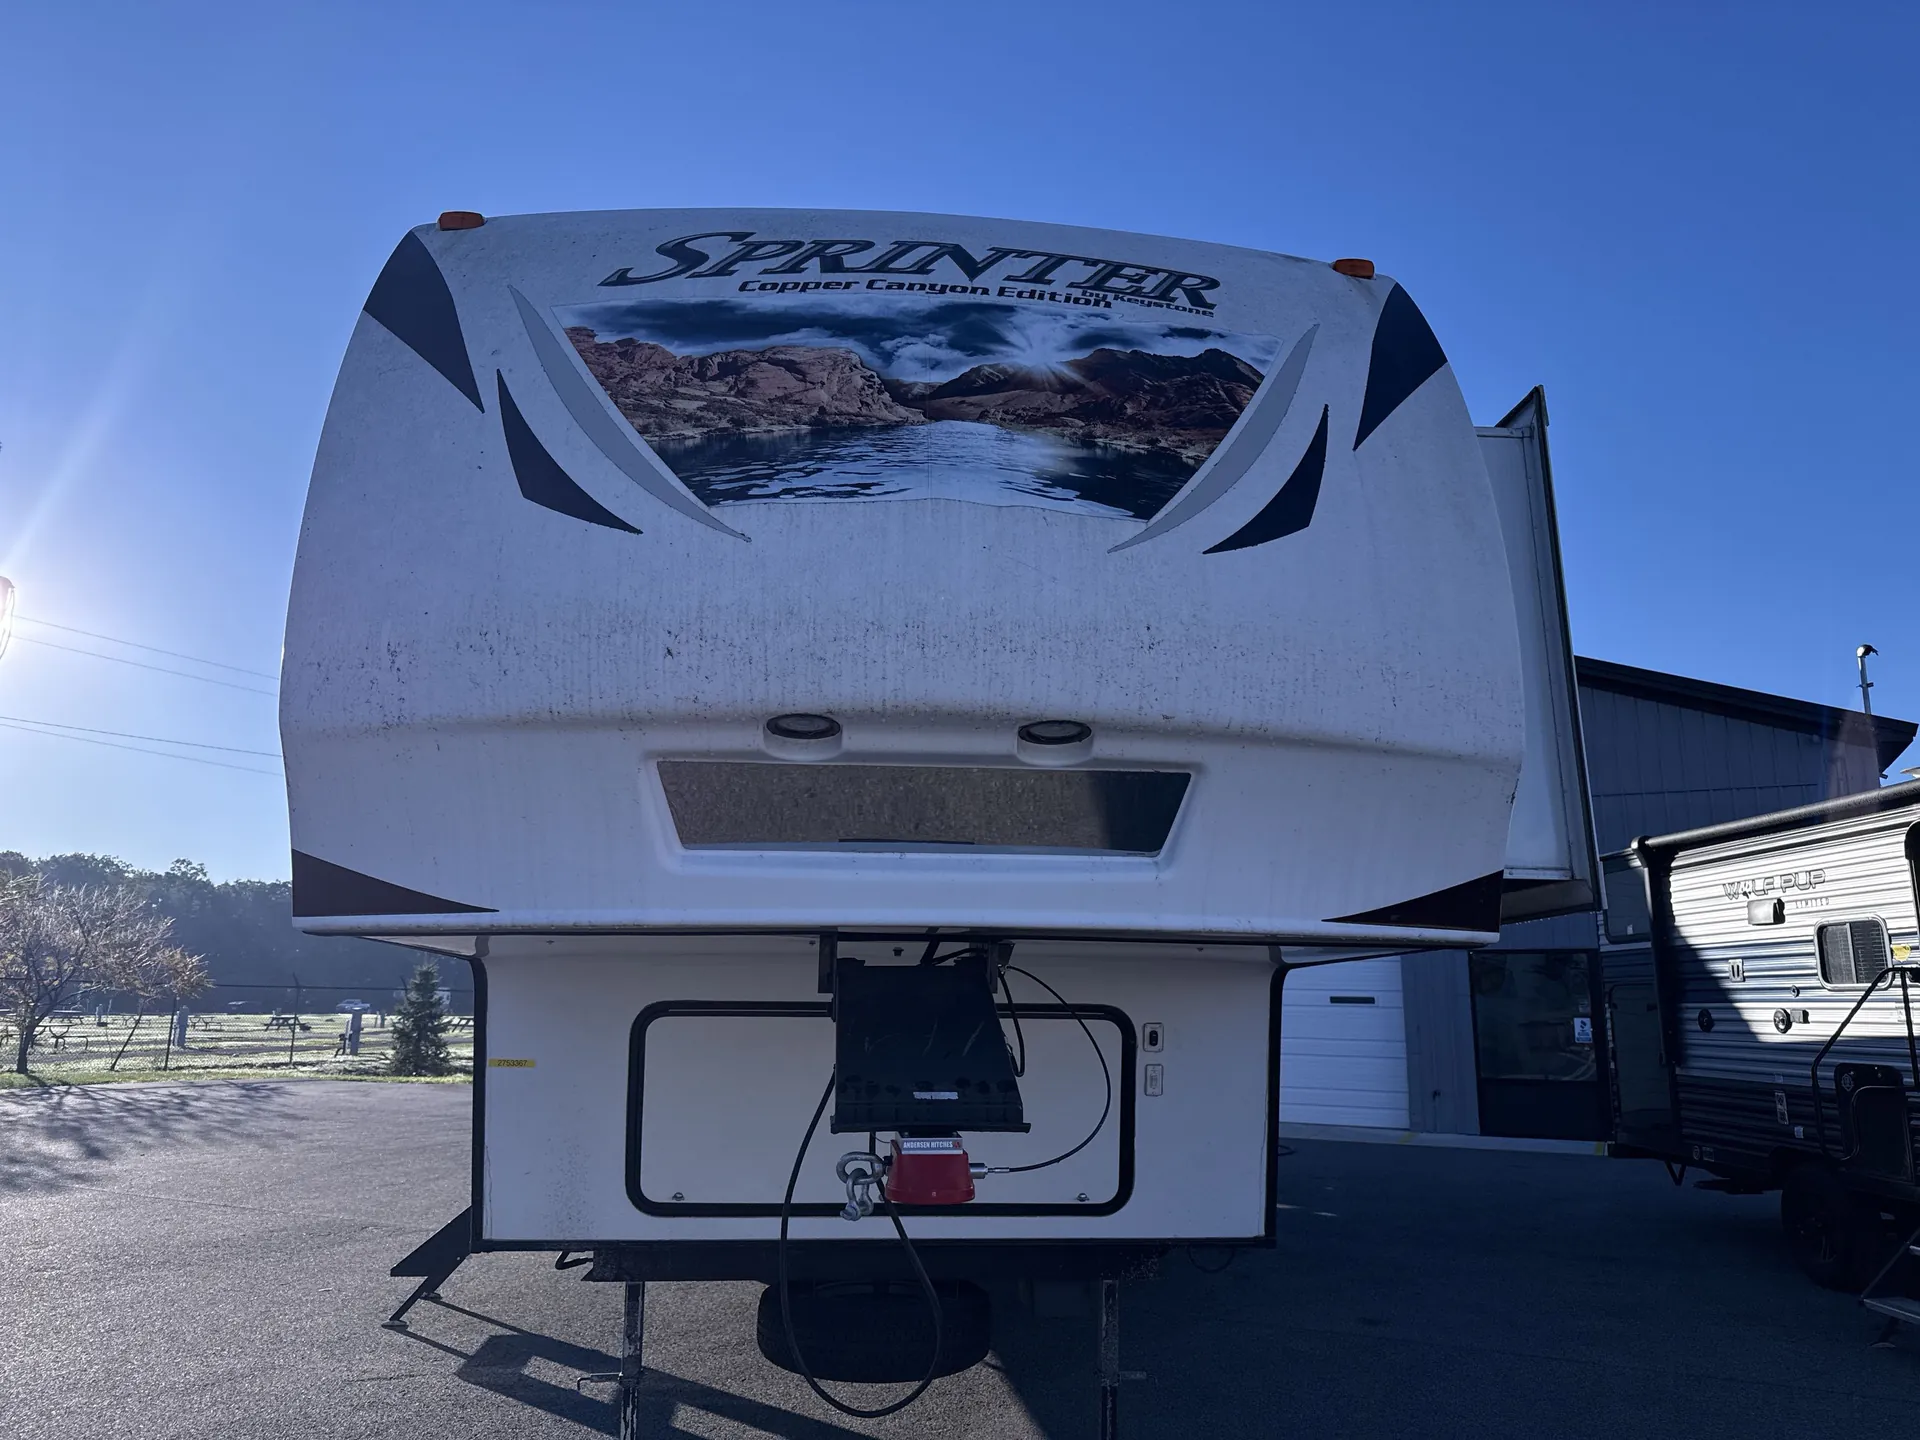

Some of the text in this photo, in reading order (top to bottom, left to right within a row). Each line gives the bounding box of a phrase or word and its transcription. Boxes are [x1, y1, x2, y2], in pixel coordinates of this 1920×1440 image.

[598, 231, 1222, 310] SPRINTER
[738, 278, 1113, 309] Copper Canyon Edition
[1081, 289, 1215, 318] by Keystone
[1780, 869, 1826, 893] PUP
[1796, 897, 1829, 908] LIMITED
